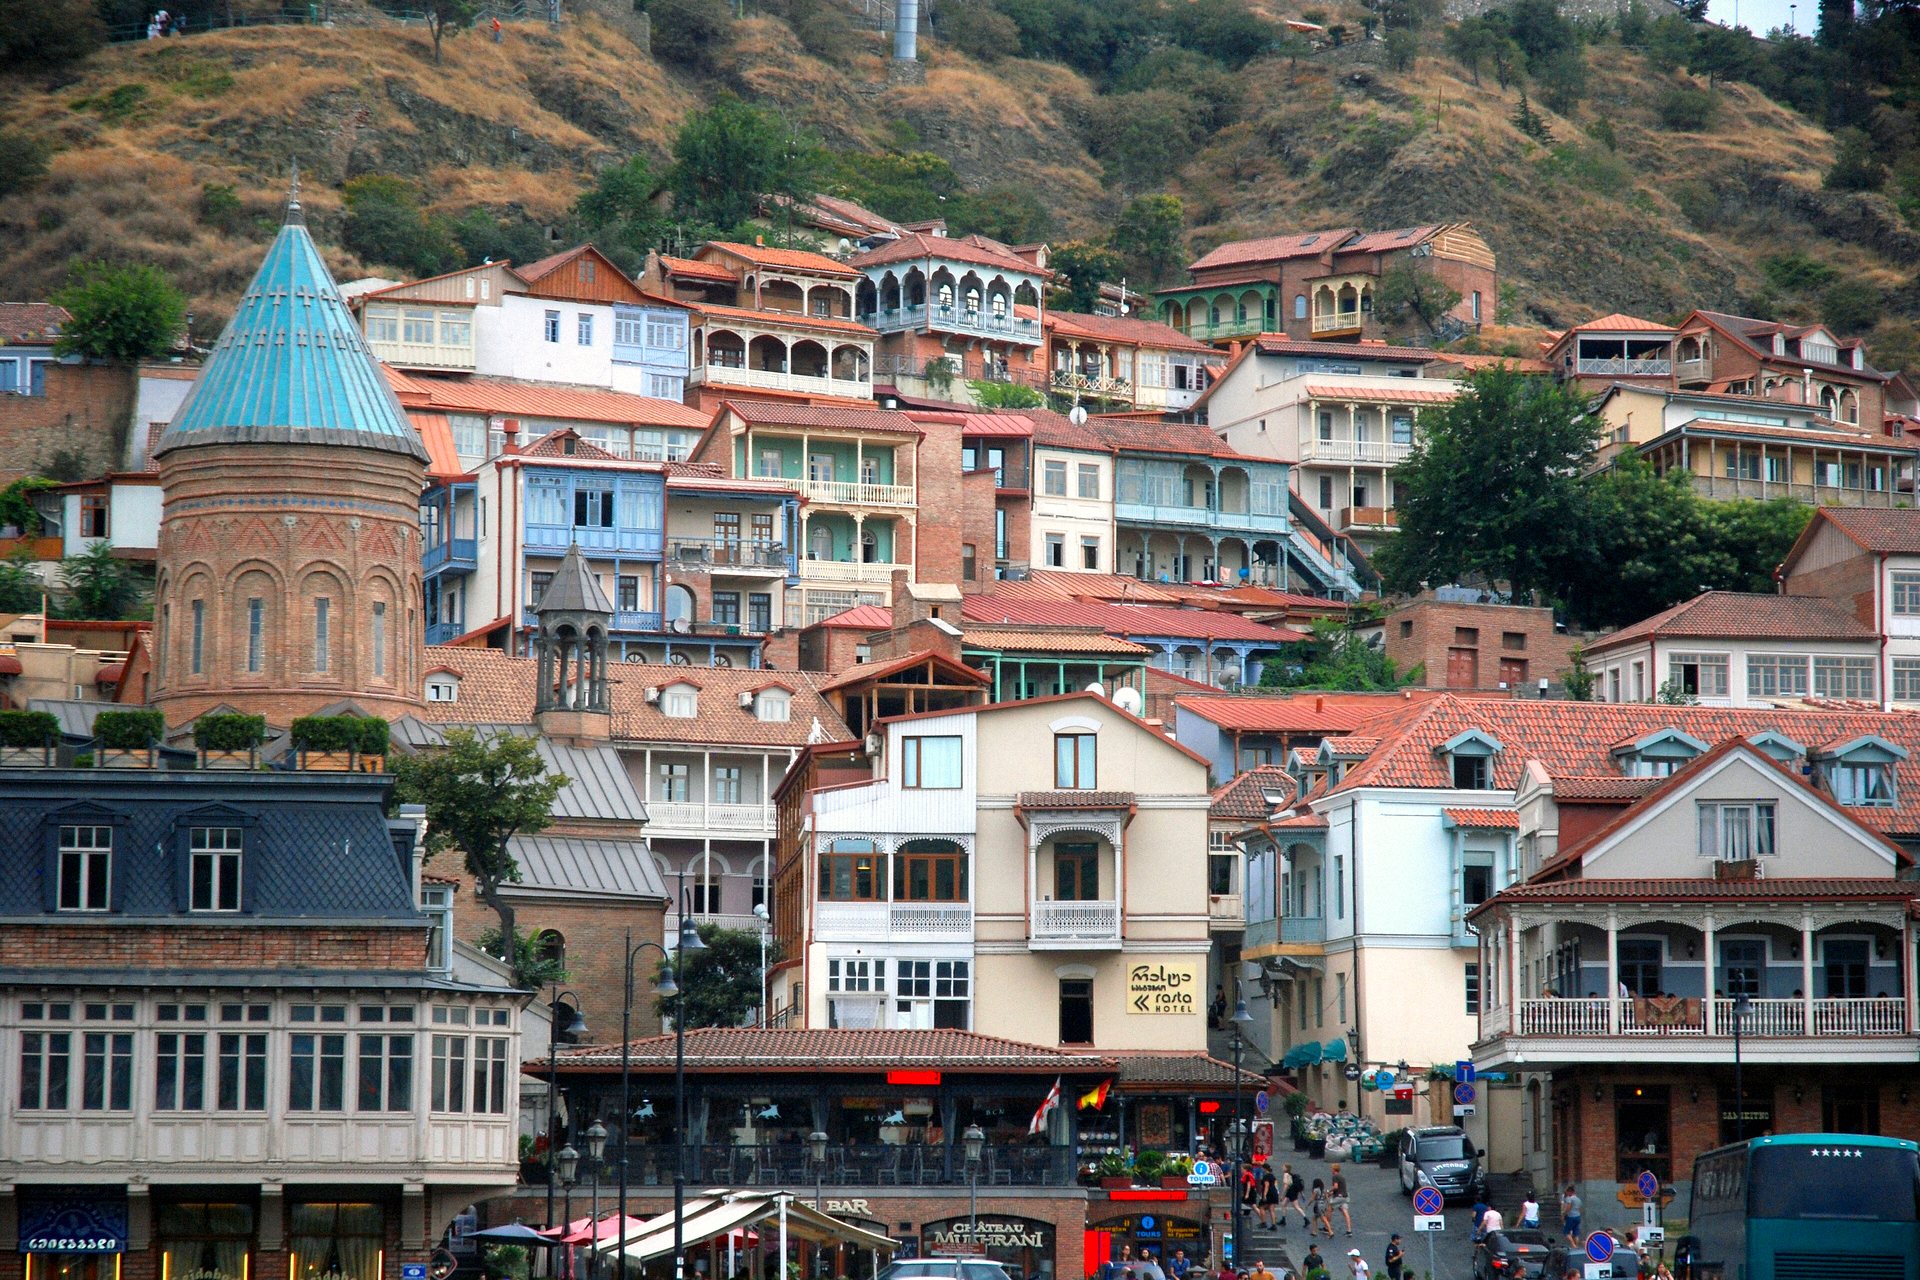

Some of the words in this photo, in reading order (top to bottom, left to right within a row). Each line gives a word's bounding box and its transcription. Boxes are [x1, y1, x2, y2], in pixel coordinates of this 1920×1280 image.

[1131, 965, 1192, 988] რასტა
[1155, 991, 1192, 1004] rasta
[1155, 1005, 1192, 1013] HOTEL
[826, 1199, 873, 1216] BAR
